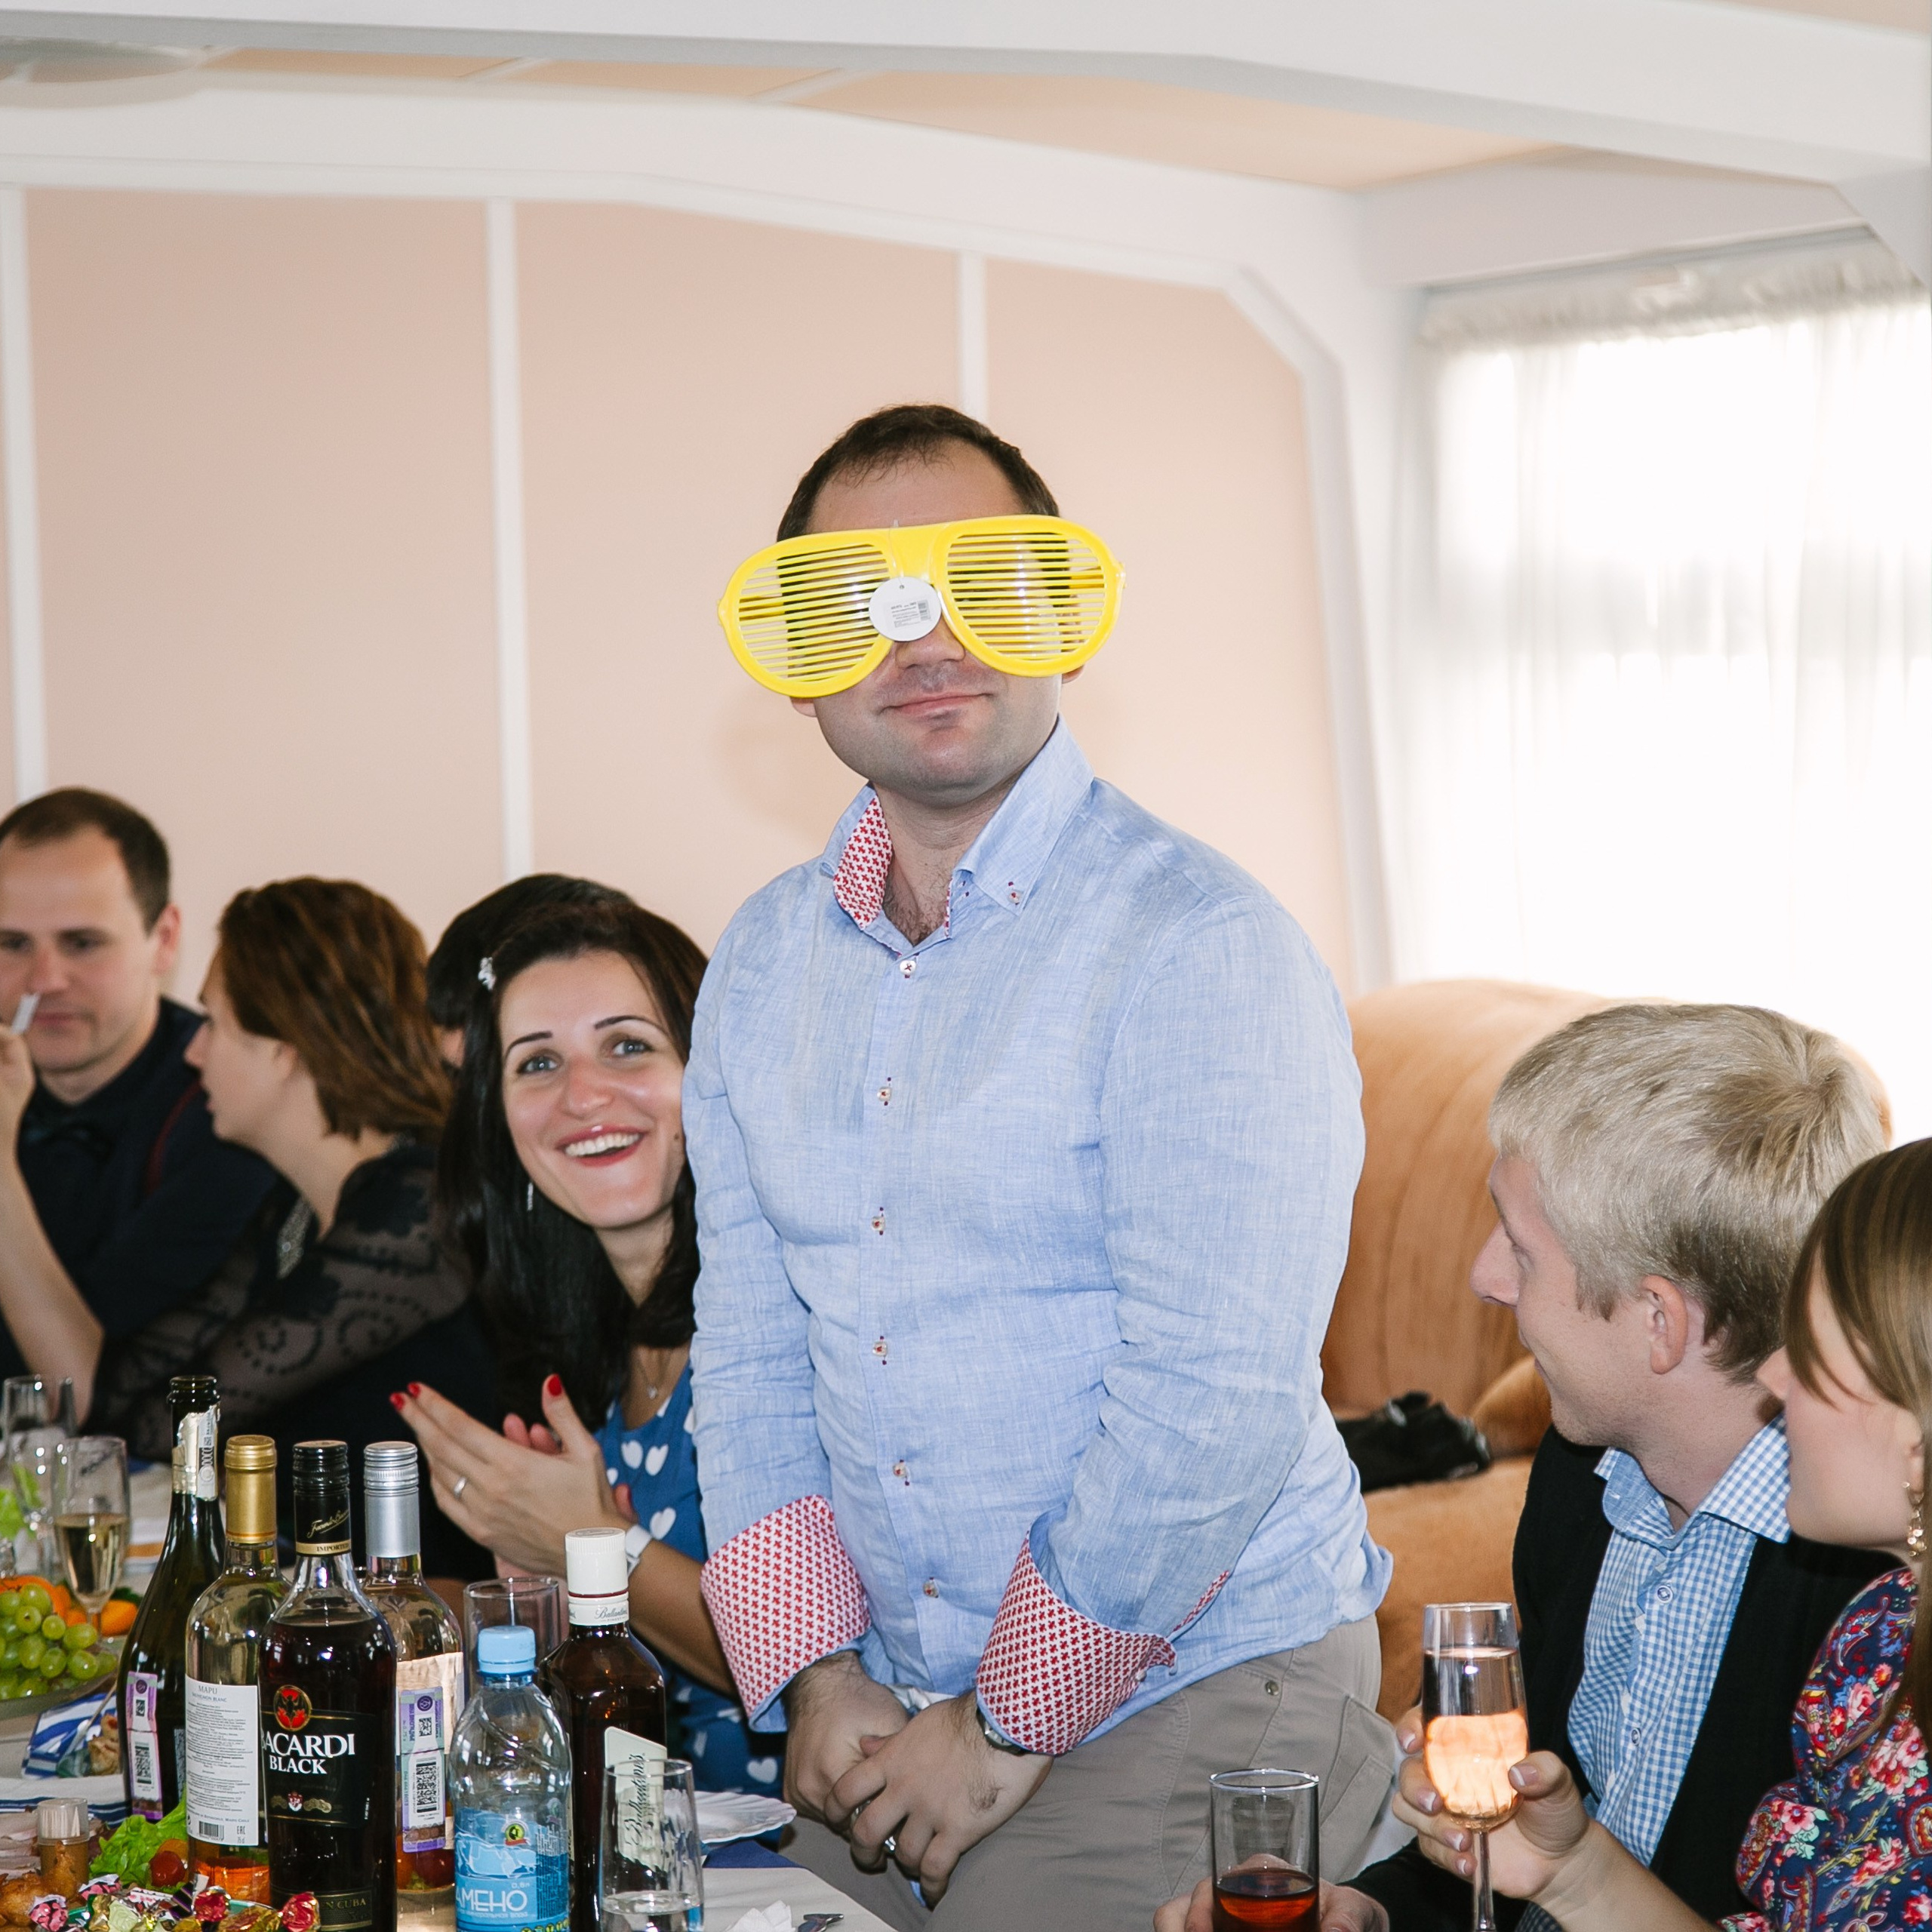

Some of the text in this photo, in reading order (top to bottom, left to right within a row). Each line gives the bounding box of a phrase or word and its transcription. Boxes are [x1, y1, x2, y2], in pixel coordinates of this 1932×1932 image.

[198, 1685, 217, 1694] MAPU
[269, 1755, 328, 1774] BLACK
[337, 1897, 367, 1909] CUBA
